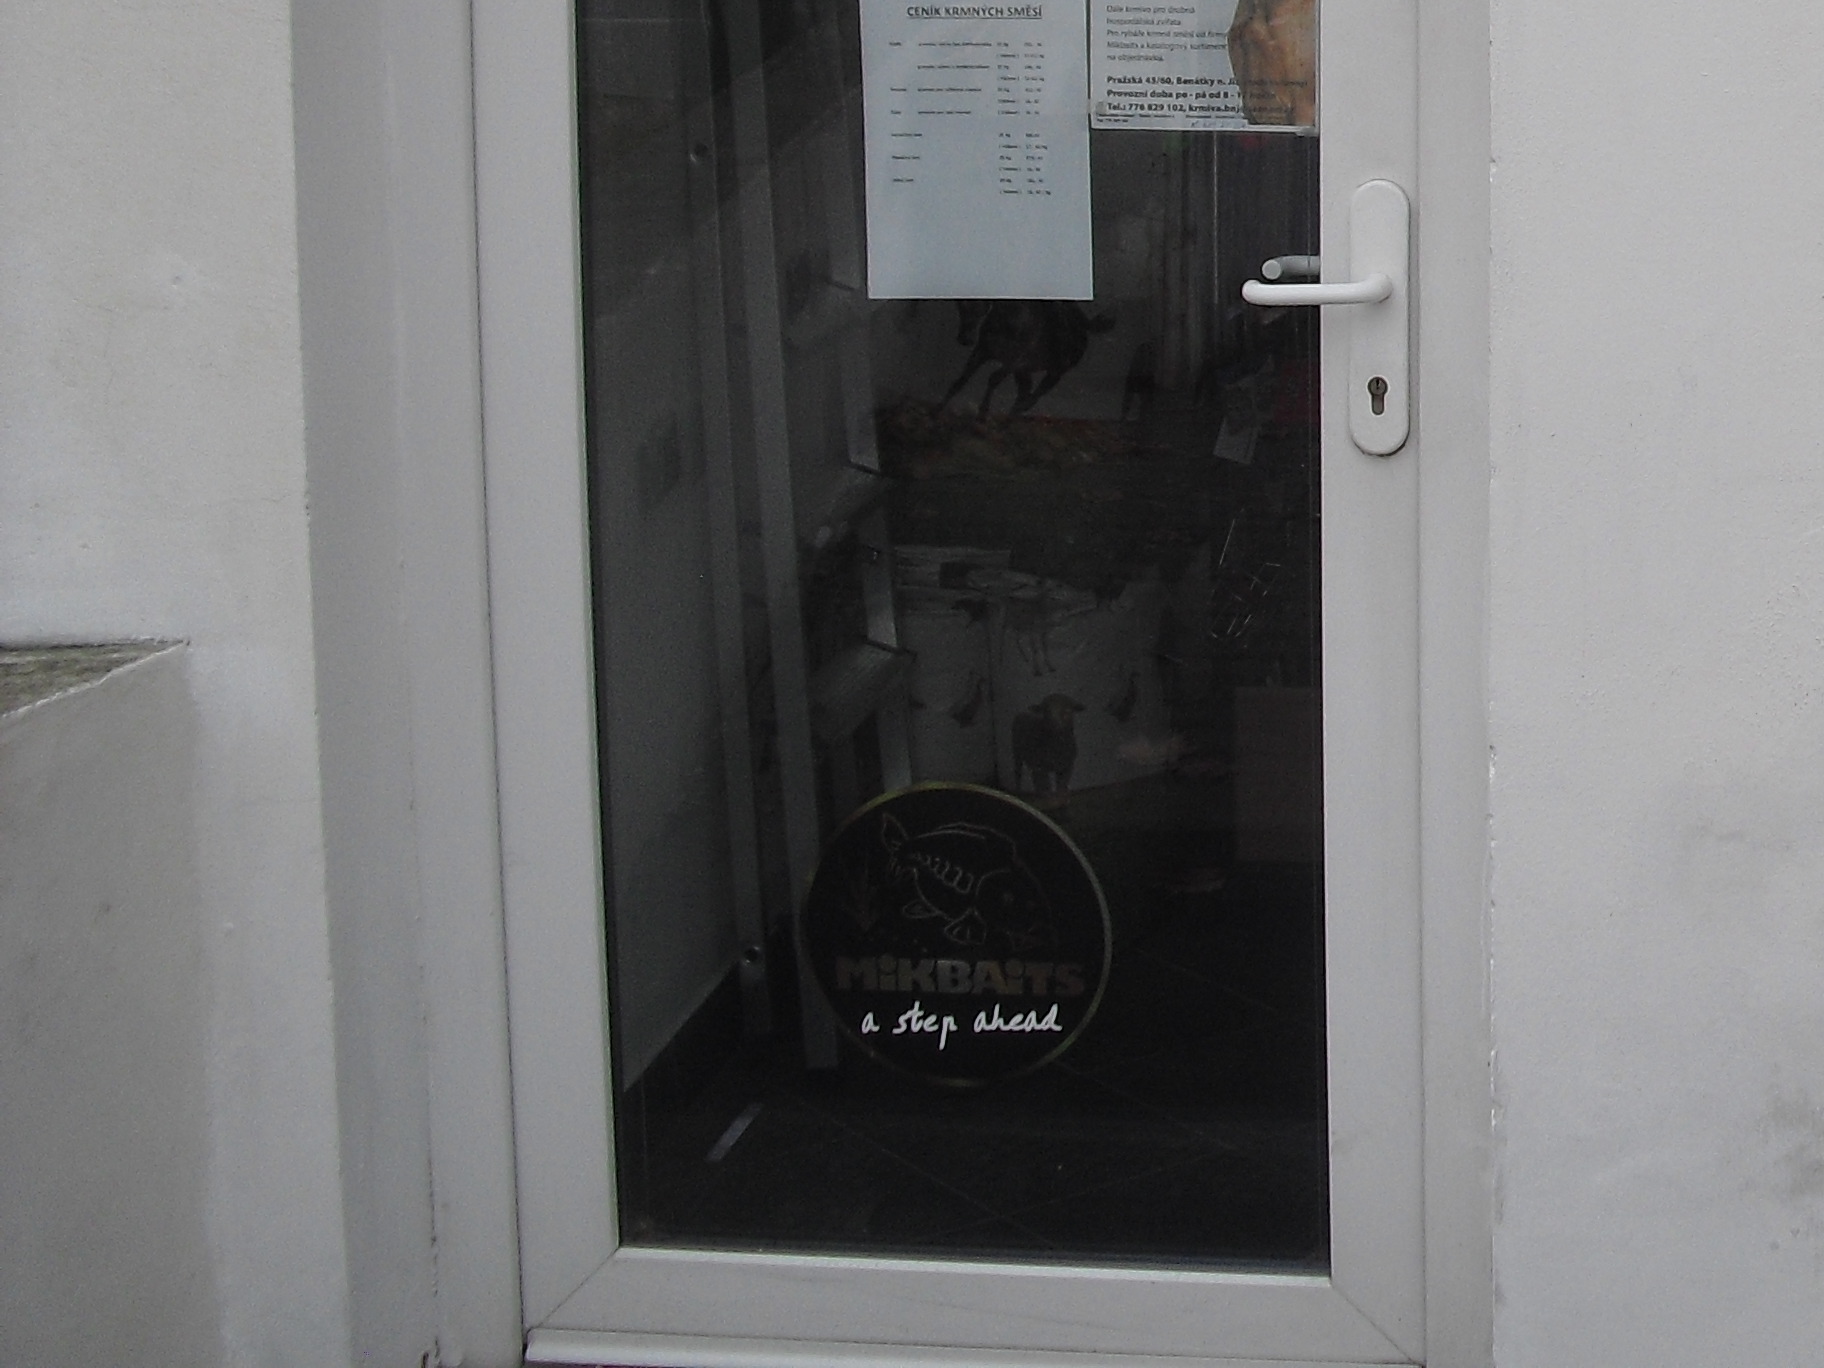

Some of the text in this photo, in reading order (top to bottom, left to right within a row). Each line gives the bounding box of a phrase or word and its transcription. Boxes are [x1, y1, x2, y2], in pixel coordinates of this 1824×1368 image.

[907, 4, 1043, 17] CENÍK KRMNÝCH SMĚSÍ
[1106, 76, 1143, 85] Pražská
[861, 999, 1063, 1051] a step ahead
